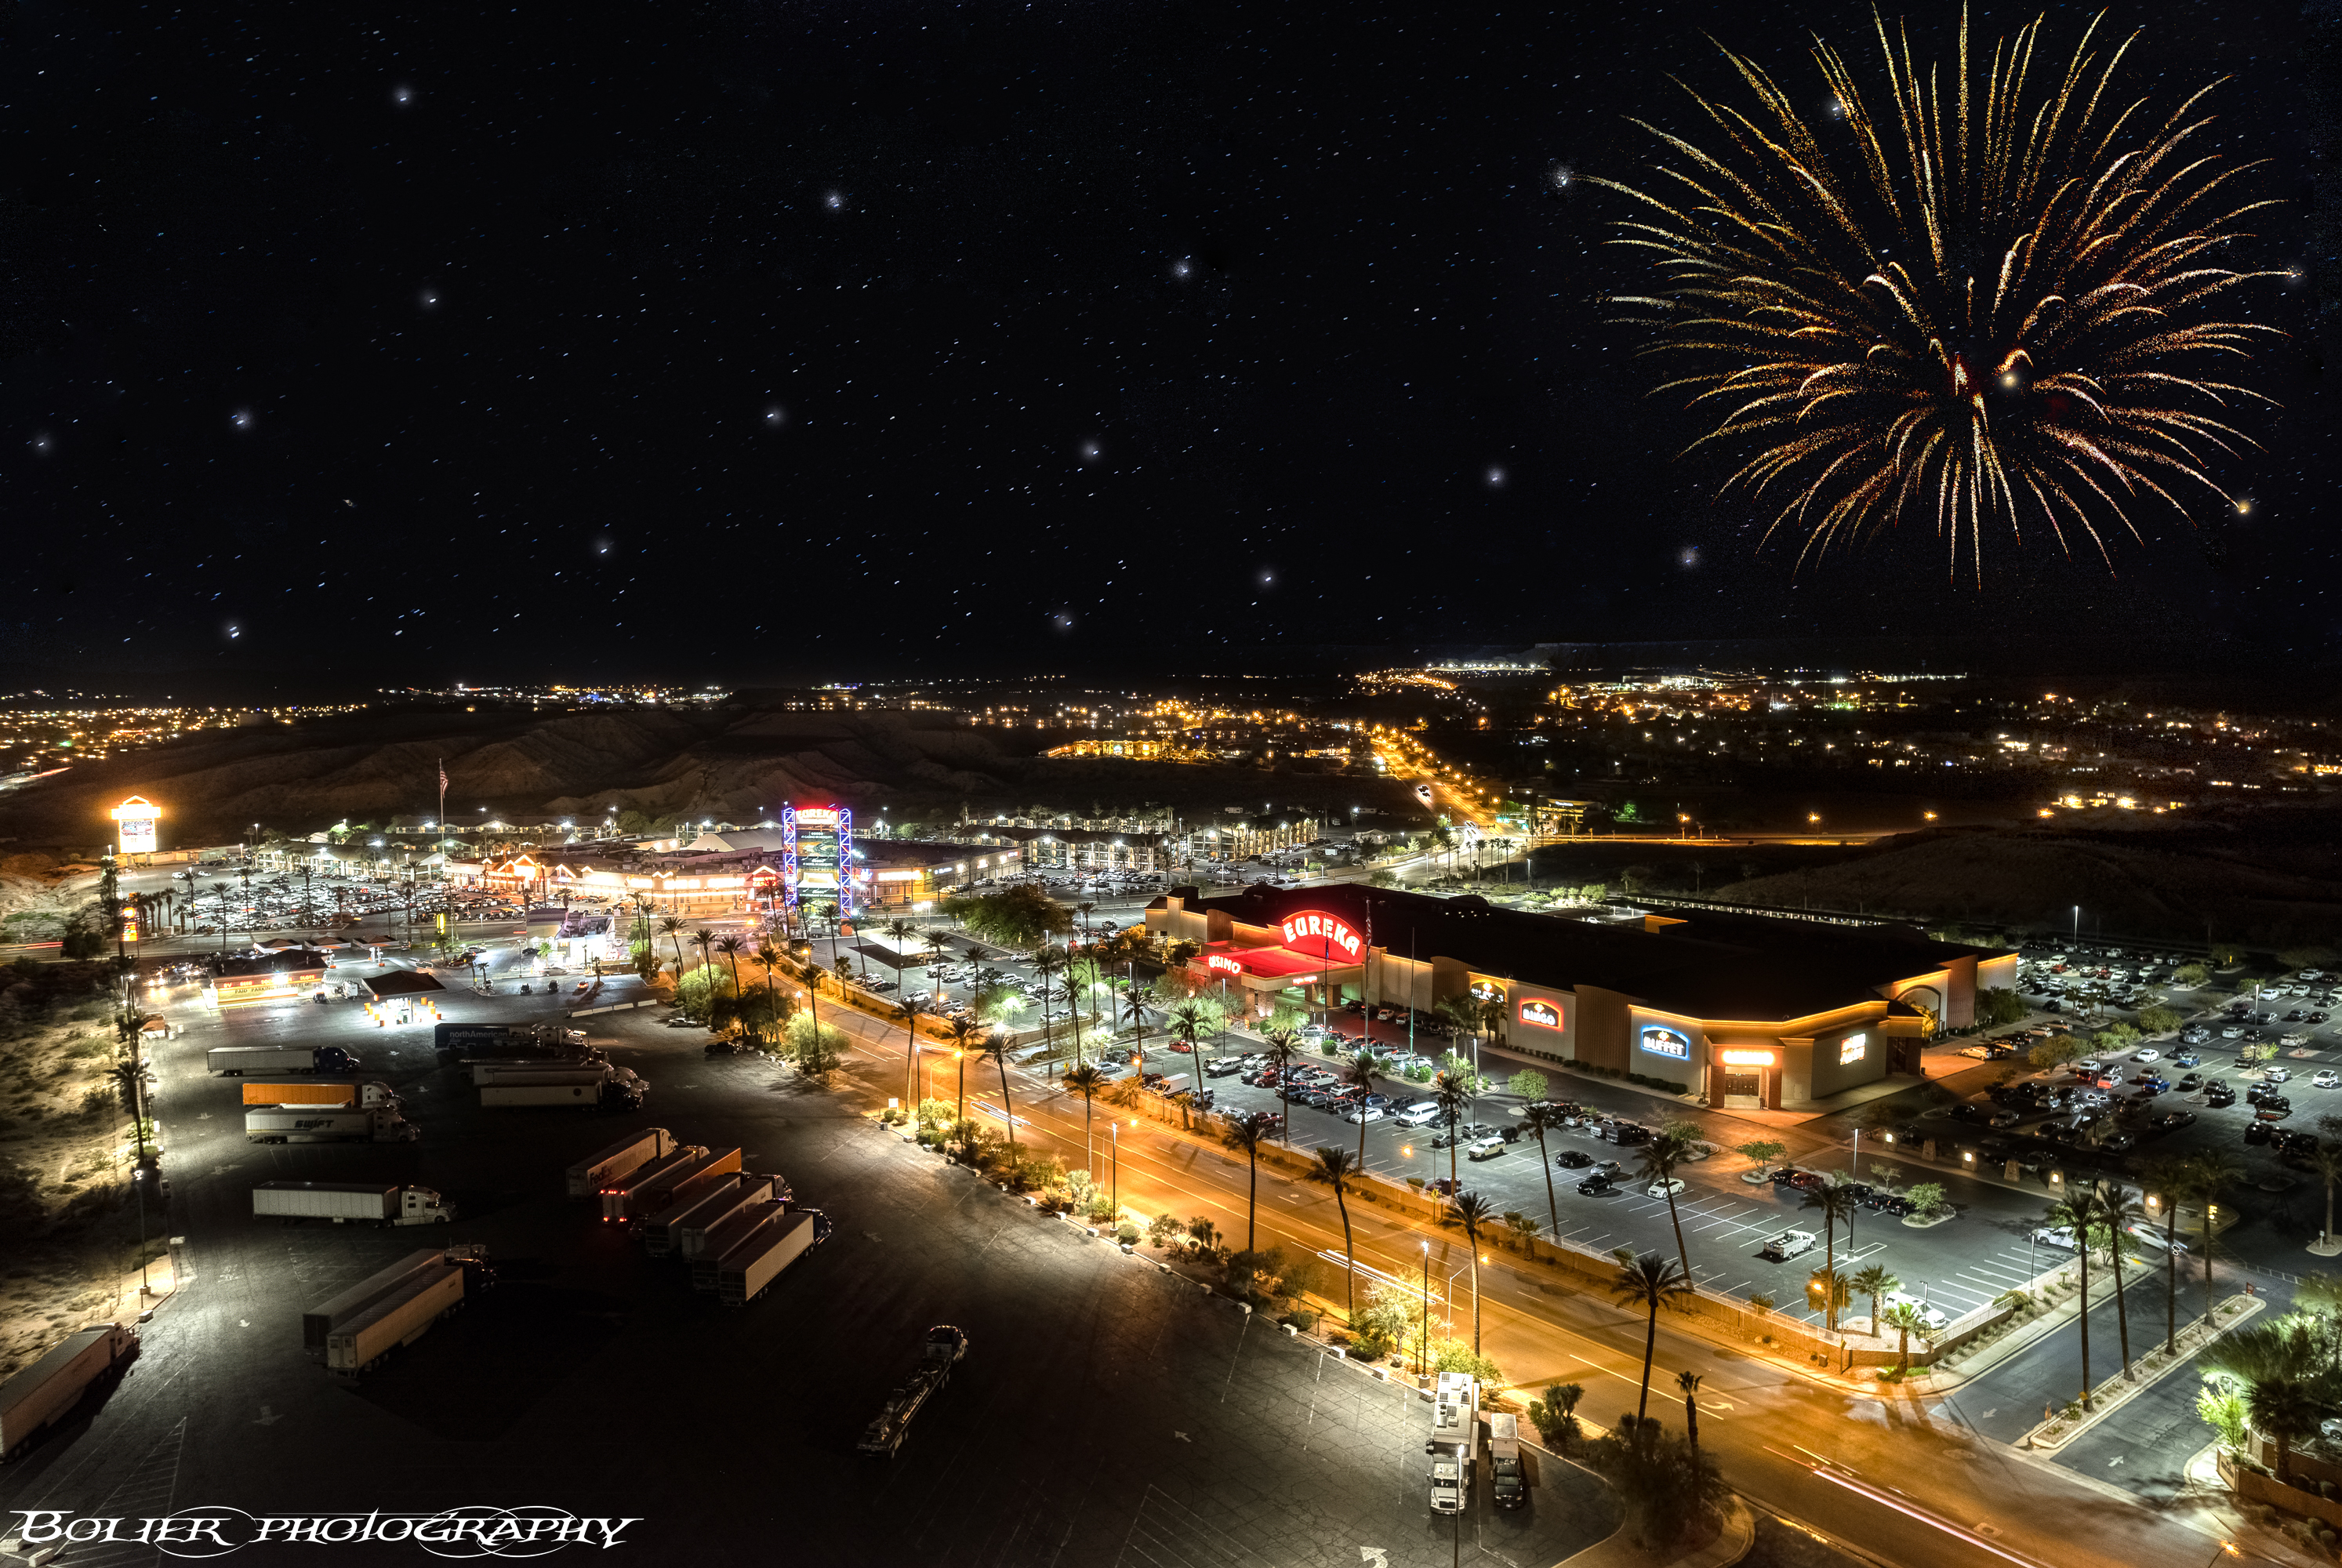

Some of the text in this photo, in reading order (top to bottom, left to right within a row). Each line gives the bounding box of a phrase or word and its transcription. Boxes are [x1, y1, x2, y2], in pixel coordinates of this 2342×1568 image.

[796, 808, 837, 819] EUREKA
[1283, 915, 1360, 956] EUREKA
[1208, 954, 1241, 975] CASINO
[1522, 1007, 1556, 1026] BINGO
[449, 1030, 508, 1039] northAmerican
[1643, 1036, 1684, 1056] BUFFET
[294, 1118, 335, 1129] SWIFT
[590, 1165, 613, 1187] FedEx
